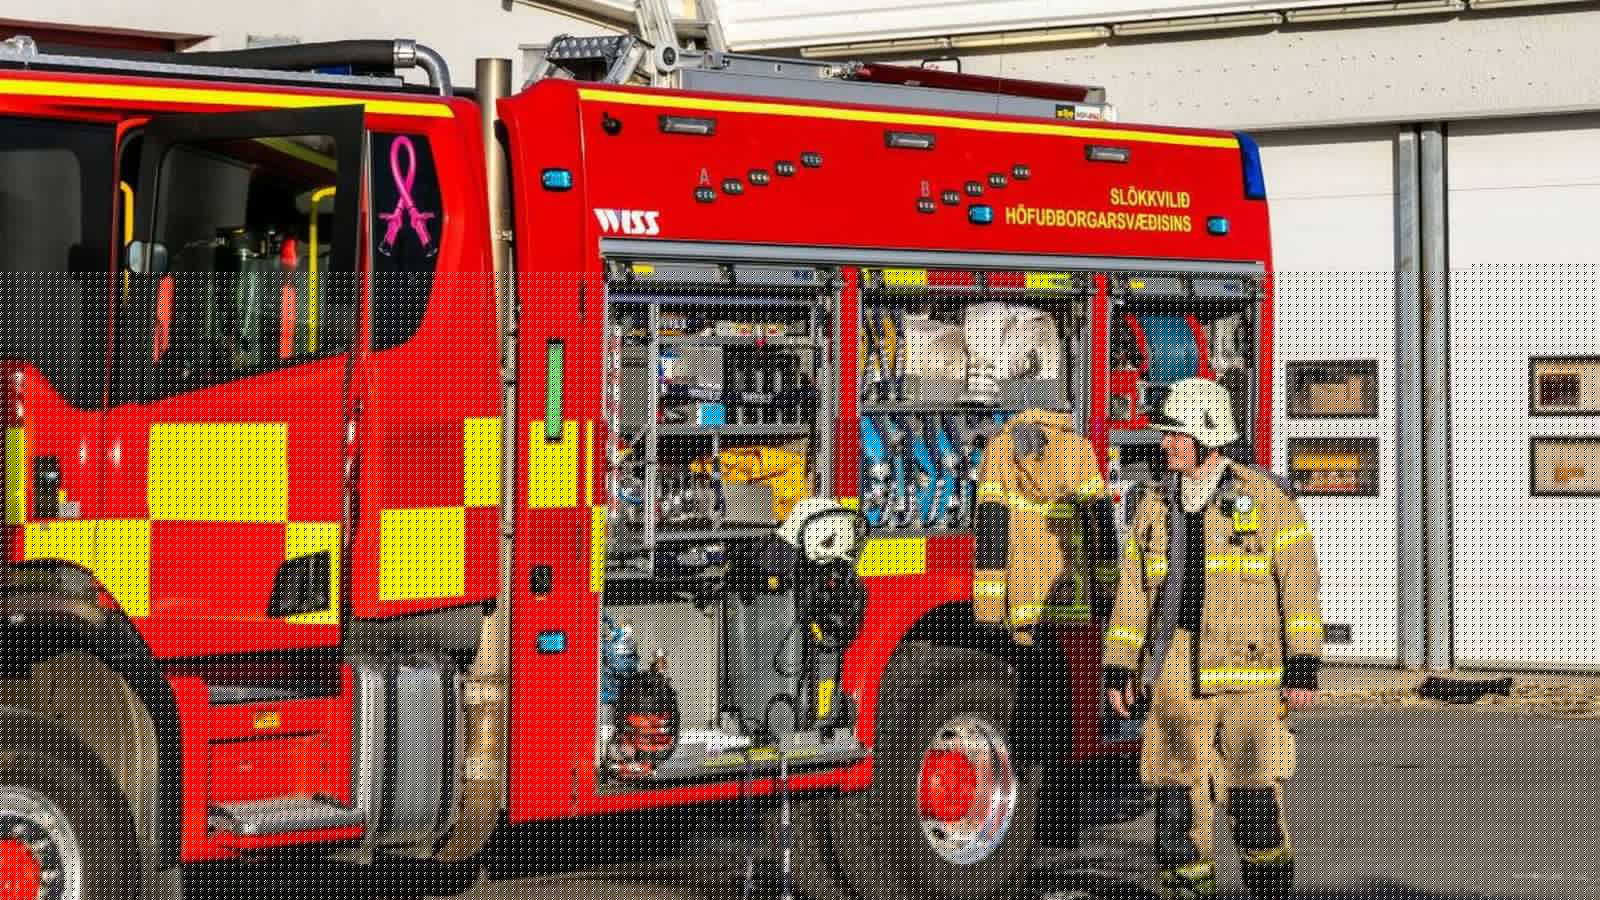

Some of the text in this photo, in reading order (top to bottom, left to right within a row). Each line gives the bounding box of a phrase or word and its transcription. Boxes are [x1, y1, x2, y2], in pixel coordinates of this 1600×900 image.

[699, 167, 710, 185] A
[1109, 186, 1191, 209] SLÖKKVILIÐ
[593, 208, 660, 235] WISS
[1005, 204, 1192, 232] HÖFUÐBORGARSVÆÐISINS
